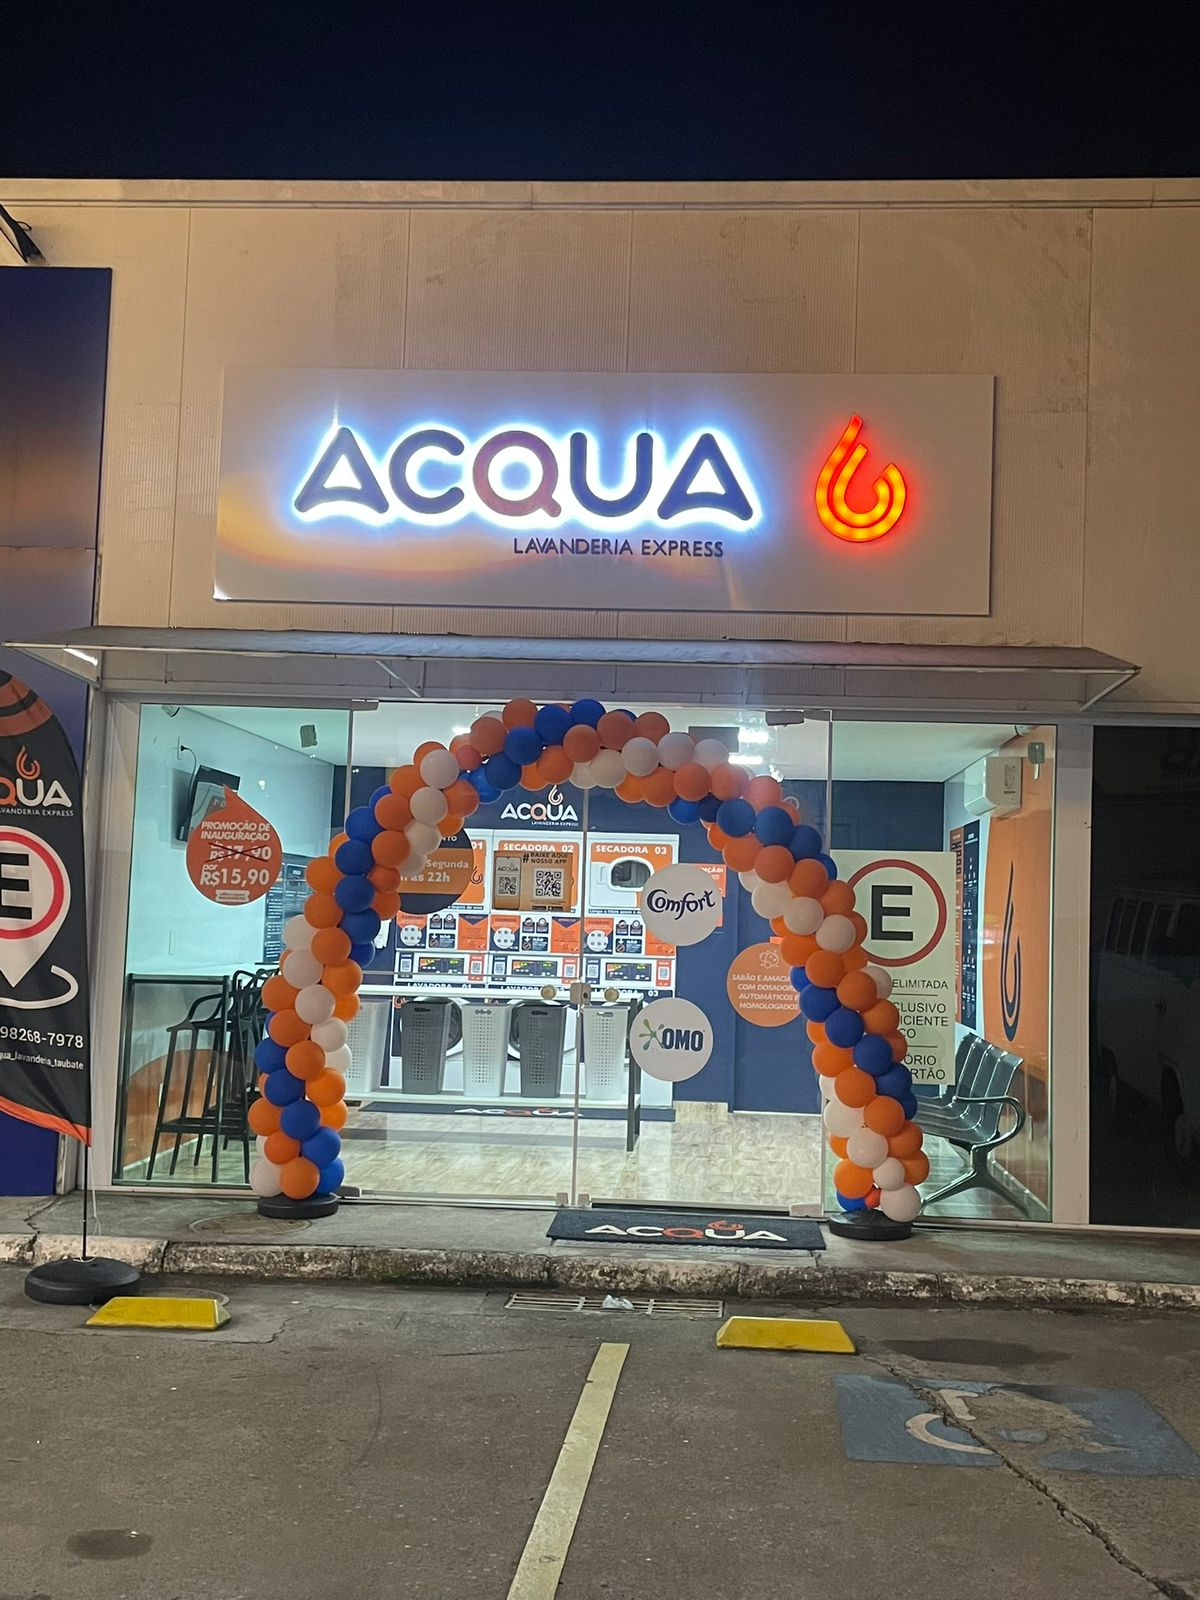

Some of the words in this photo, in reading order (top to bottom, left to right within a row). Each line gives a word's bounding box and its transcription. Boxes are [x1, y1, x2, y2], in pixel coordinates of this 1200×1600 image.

[293, 425, 754, 522] ACQUA
[513, 537, 634, 556] LAVANDERIA
[641, 539, 724, 558] EXPRESS
[0, 807, 40, 816] VANDERIA
[42, 809, 74, 817] EXPRESS
[500, 802, 579, 821] ACQUA
[258, 822, 271, 832] DE
[471, 841, 483, 850] 01
[503, 843, 556, 852] SECADORA
[561, 845, 574, 853] 02
[595, 844, 649, 855] SECADORA
[654, 846, 667, 855] 03
[426, 858, 469, 869] Segunda
[427, 871, 450, 882] 22h
[646, 888, 716, 920] Comfort
[871, 884, 914, 942] E
[648, 989, 660, 997] 03
[738, 992, 793, 1001] AUTOMÁTICOS
[0, 1026, 84, 1049] 98268-7978
[662, 1028, 704, 1052] OMO
[911, 1067, 946, 1081] RTÃO
[584, 1224, 788, 1242] ACQUA
